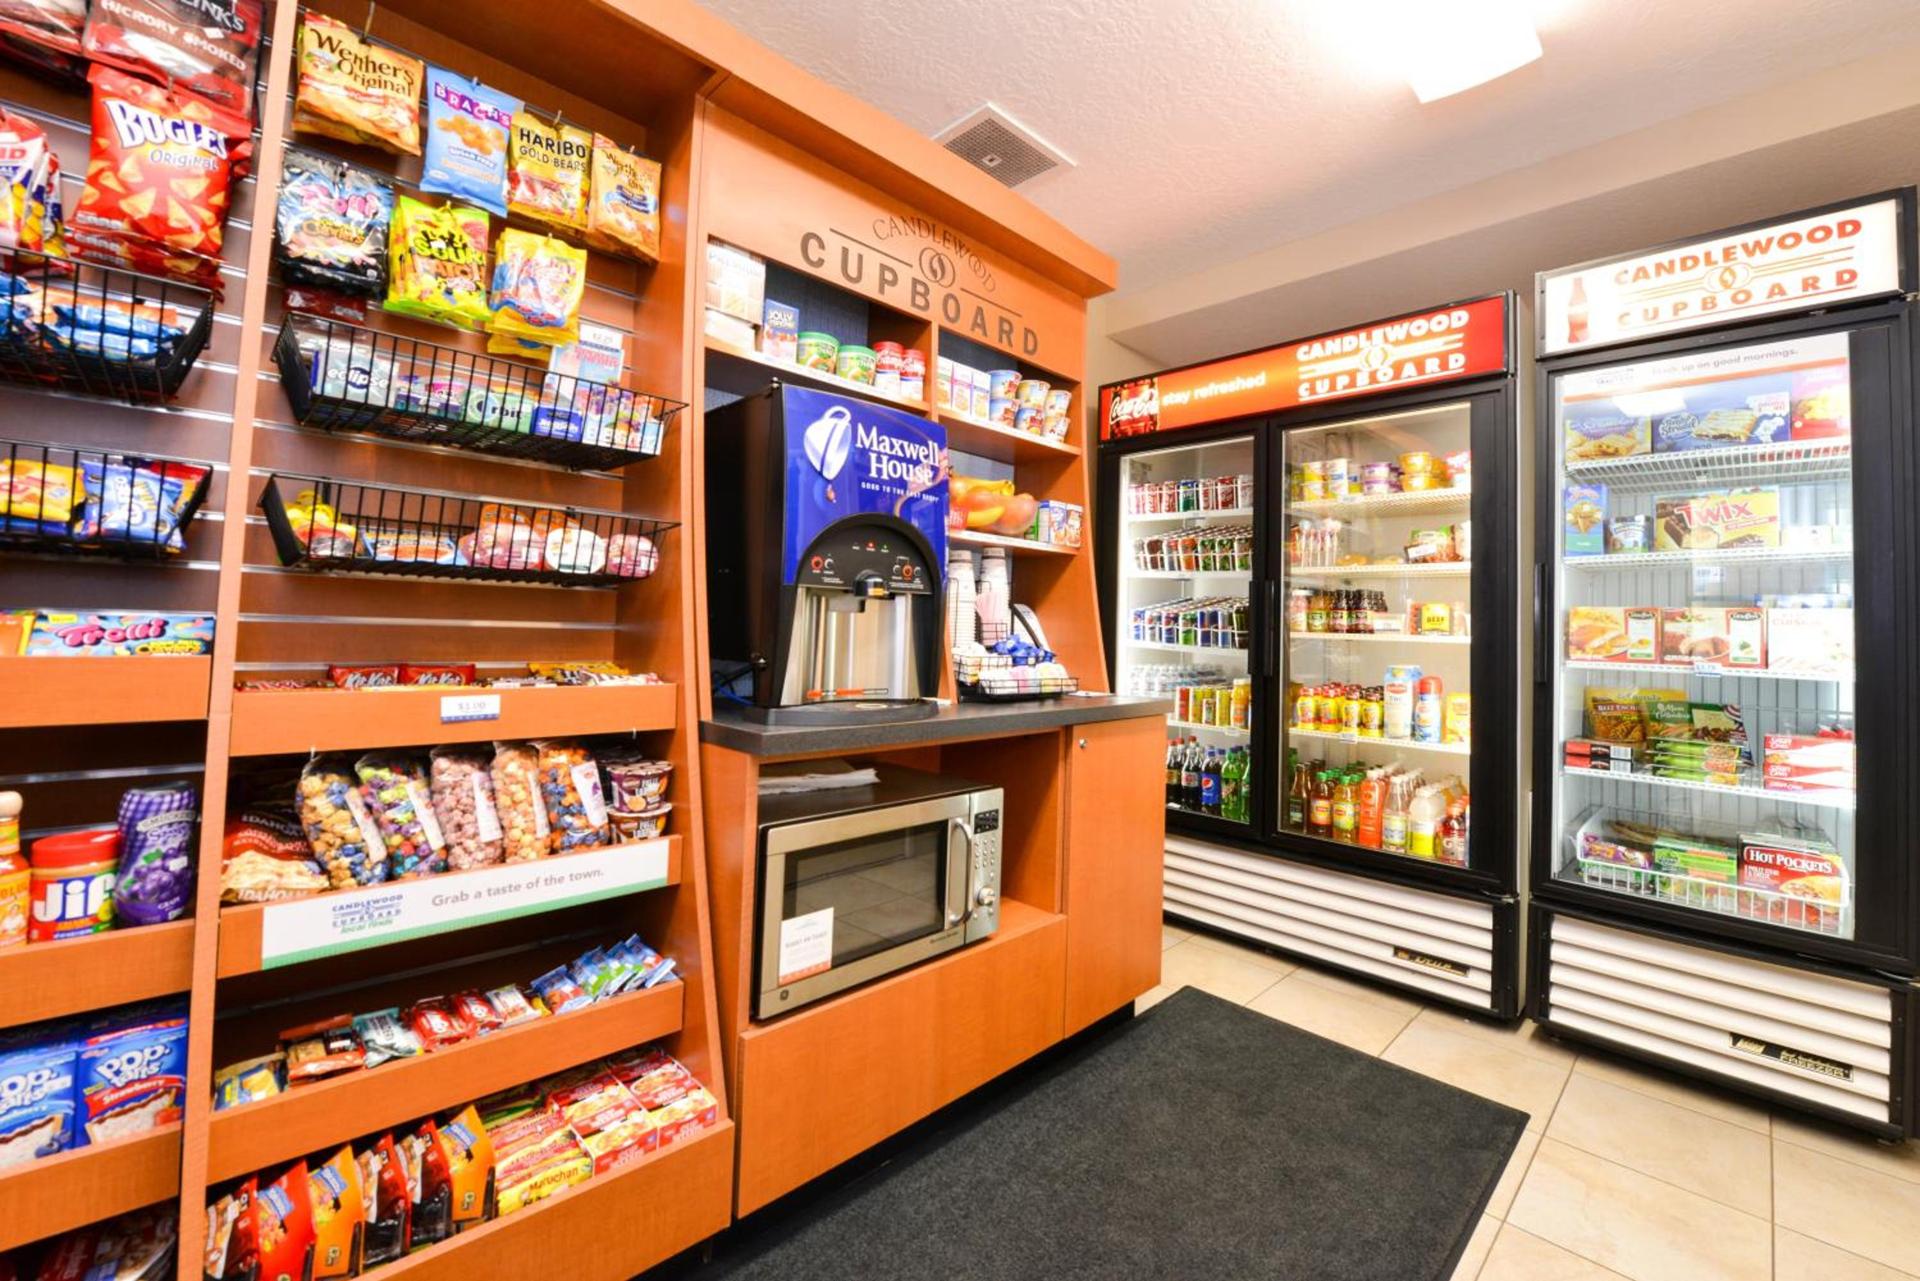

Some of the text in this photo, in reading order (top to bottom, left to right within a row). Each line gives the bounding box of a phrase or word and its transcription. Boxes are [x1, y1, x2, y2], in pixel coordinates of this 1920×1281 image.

[337, 59, 413, 97] Original
[519, 127, 587, 159] HARIBO
[519, 145, 550, 165] GOLD
[871, 214, 997, 294] CANDLEWOOD
[1613, 218, 1864, 286] CANDLEWOOD
[800, 230, 1039, 357] CUPBOARD
[1616, 267, 1860, 328] CUPBOARD
[1296, 309, 1470, 362] CANDLEWOOD
[327, 366, 390, 391] eclipse
[1298, 352, 1468, 399] CUPBOARD
[1713, 355, 1742, 369] good
[1193, 371, 1267, 400] refreshed
[855, 421, 940, 467] Maxwell
[868, 452, 936, 487] House
[58, 618, 167, 649] Trolli
[1776, 854, 1833, 874] POCKETS
[33, 872, 117, 922] Jif
[331, 894, 403, 912] CANDLEWOOD
[431, 891, 470, 908] Grab
[473, 890, 483, 900] a
[486, 883, 522, 897] taste
[526, 878, 541, 891] of
[543, 874, 565, 887] the
[331, 908, 402, 929] CUPBOARD
[528, 1166, 579, 1191] Maruchan
